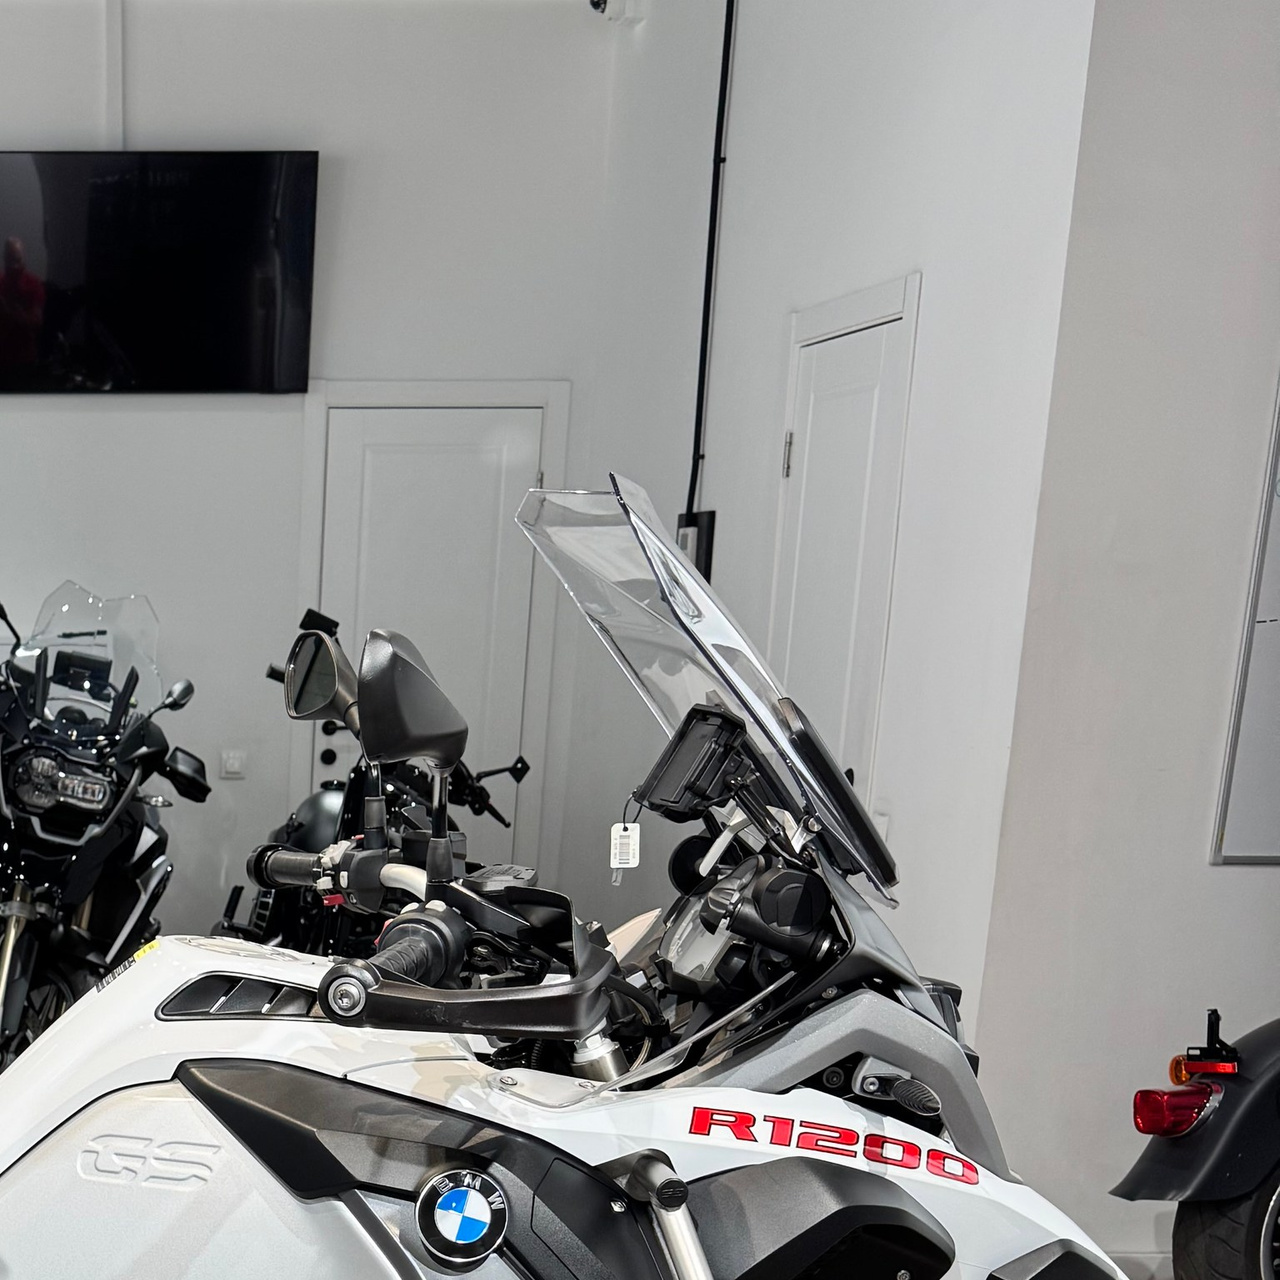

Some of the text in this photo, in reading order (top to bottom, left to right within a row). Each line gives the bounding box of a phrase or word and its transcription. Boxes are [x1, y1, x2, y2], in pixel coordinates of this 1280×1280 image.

[76, 1133, 223, 1192] GS
[688, 1106, 980, 1186] R1200
[433, 1170, 505, 1212] BMW
